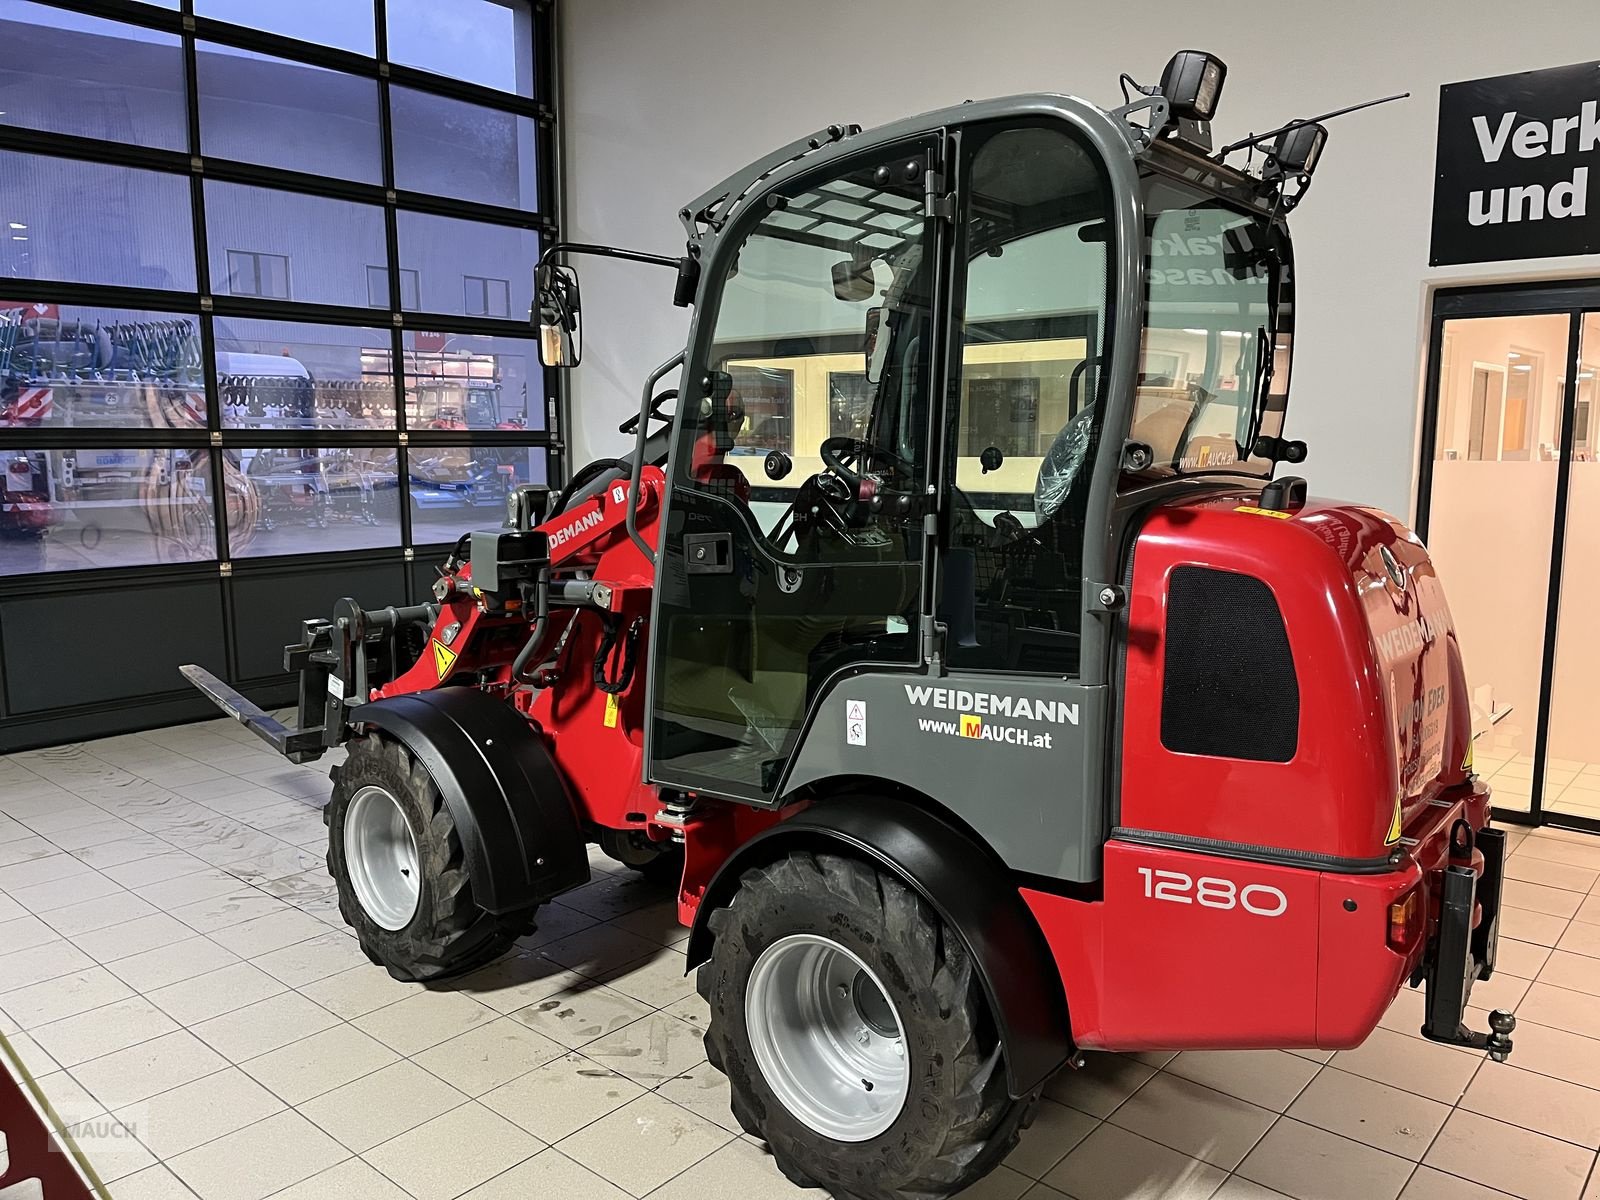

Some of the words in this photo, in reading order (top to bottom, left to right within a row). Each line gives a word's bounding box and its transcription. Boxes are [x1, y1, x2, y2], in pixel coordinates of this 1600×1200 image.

[1468, 167, 1588, 226] und
[548, 508, 604, 550] DEMANN
[1376, 607, 1454, 663] WEIDEMANN
[904, 684, 1079, 726] WEIDEMANN
[918, 717, 1052, 749] www.MAUCH.at
[1138, 867, 1288, 917] 1280
